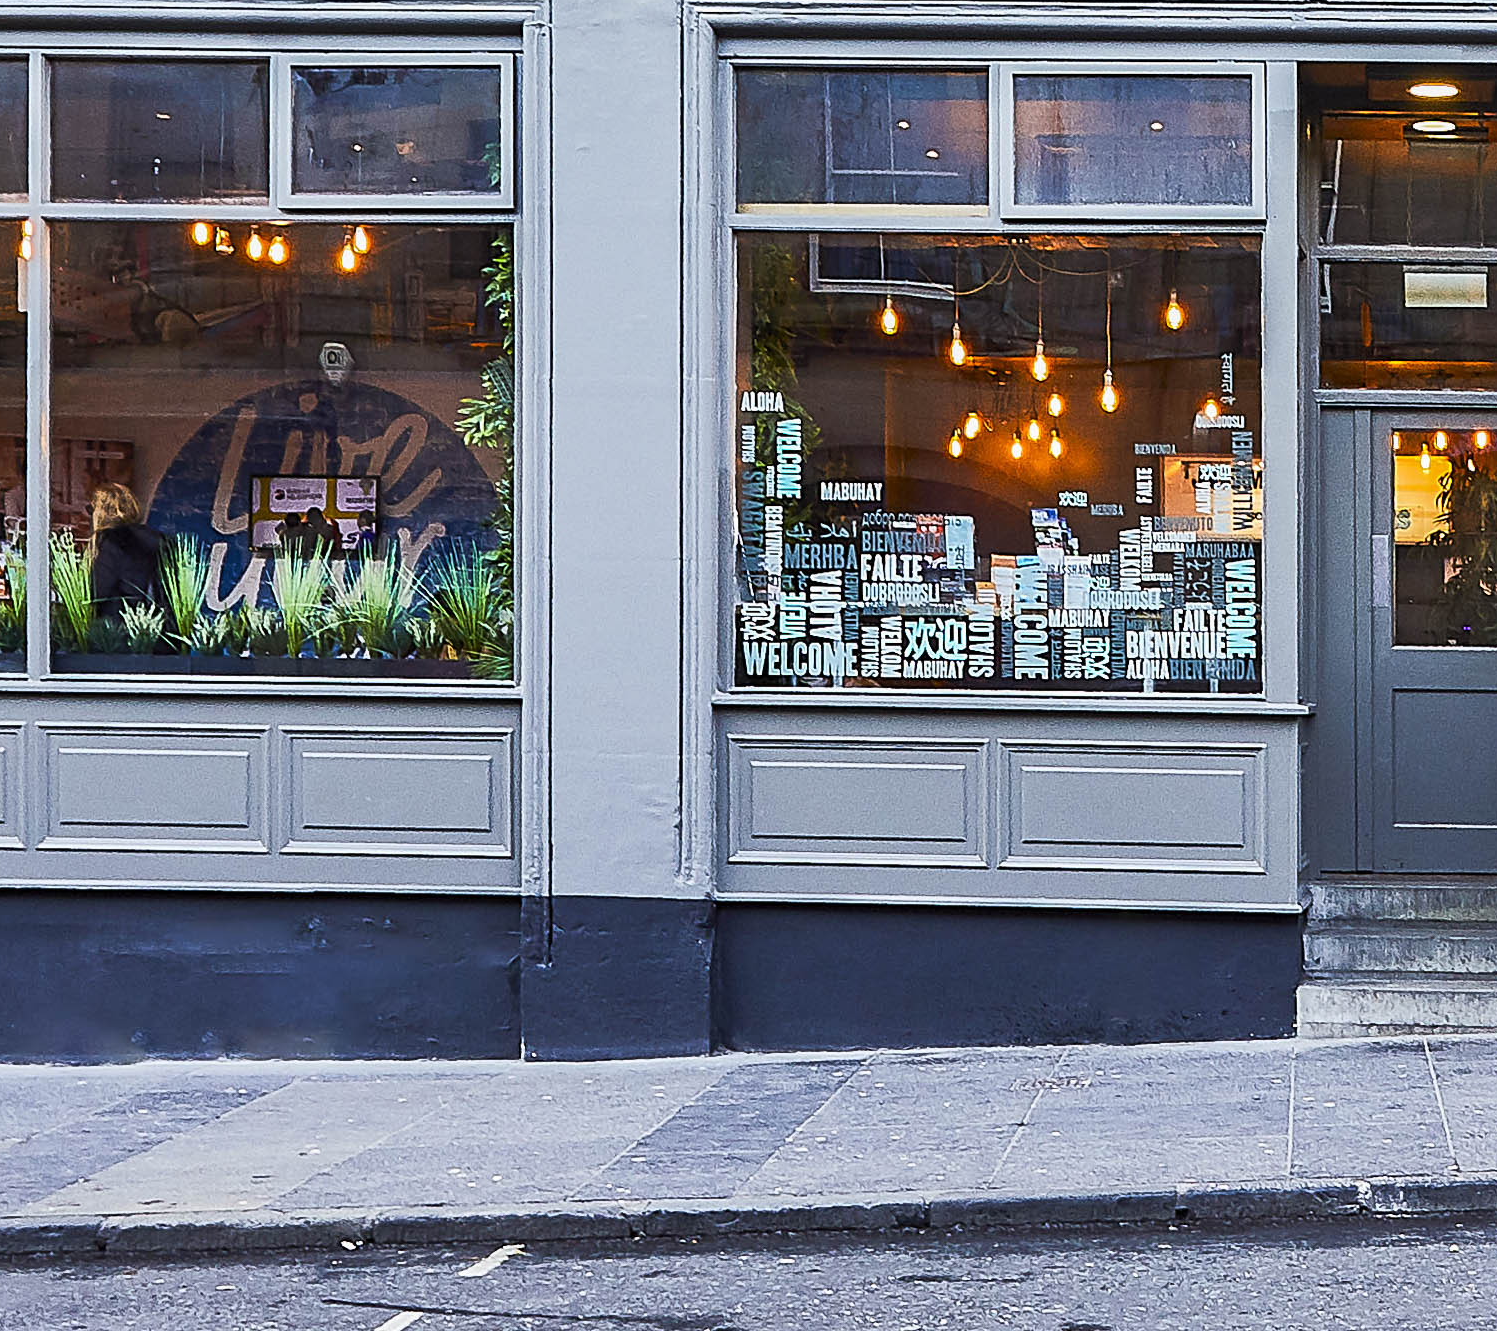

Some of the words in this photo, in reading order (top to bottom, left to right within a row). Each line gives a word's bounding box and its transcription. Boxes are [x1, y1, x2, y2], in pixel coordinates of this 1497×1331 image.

[740, 390, 785, 413] ALOHA
[776, 417, 802, 500] WELCOME
[819, 481, 884, 502] MABUHAY
[1135, 467, 1153, 505] FAILTE
[860, 553, 924, 583] FAILTE
[1118, 529, 1142, 592] WELKOM
[808, 569, 843, 640] ALOHA
[1048, 609, 1111, 629] MABUHAY
[1172, 608, 1227, 632] FAILTE
[1224, 558, 1257, 660] WELCOME
[860, 626, 881, 678] SHALOM
[880, 615, 903, 679] WELKOM
[903, 616, 969, 661] 欢迎
[1063, 628, 1083, 679] SHALOM
[1126, 630, 1228, 660] BIENVENUE
[742, 641, 859, 677] WELCOME
[902, 660, 965, 679] MABUHAY
[1125, 658, 1170, 680] ALOHA
